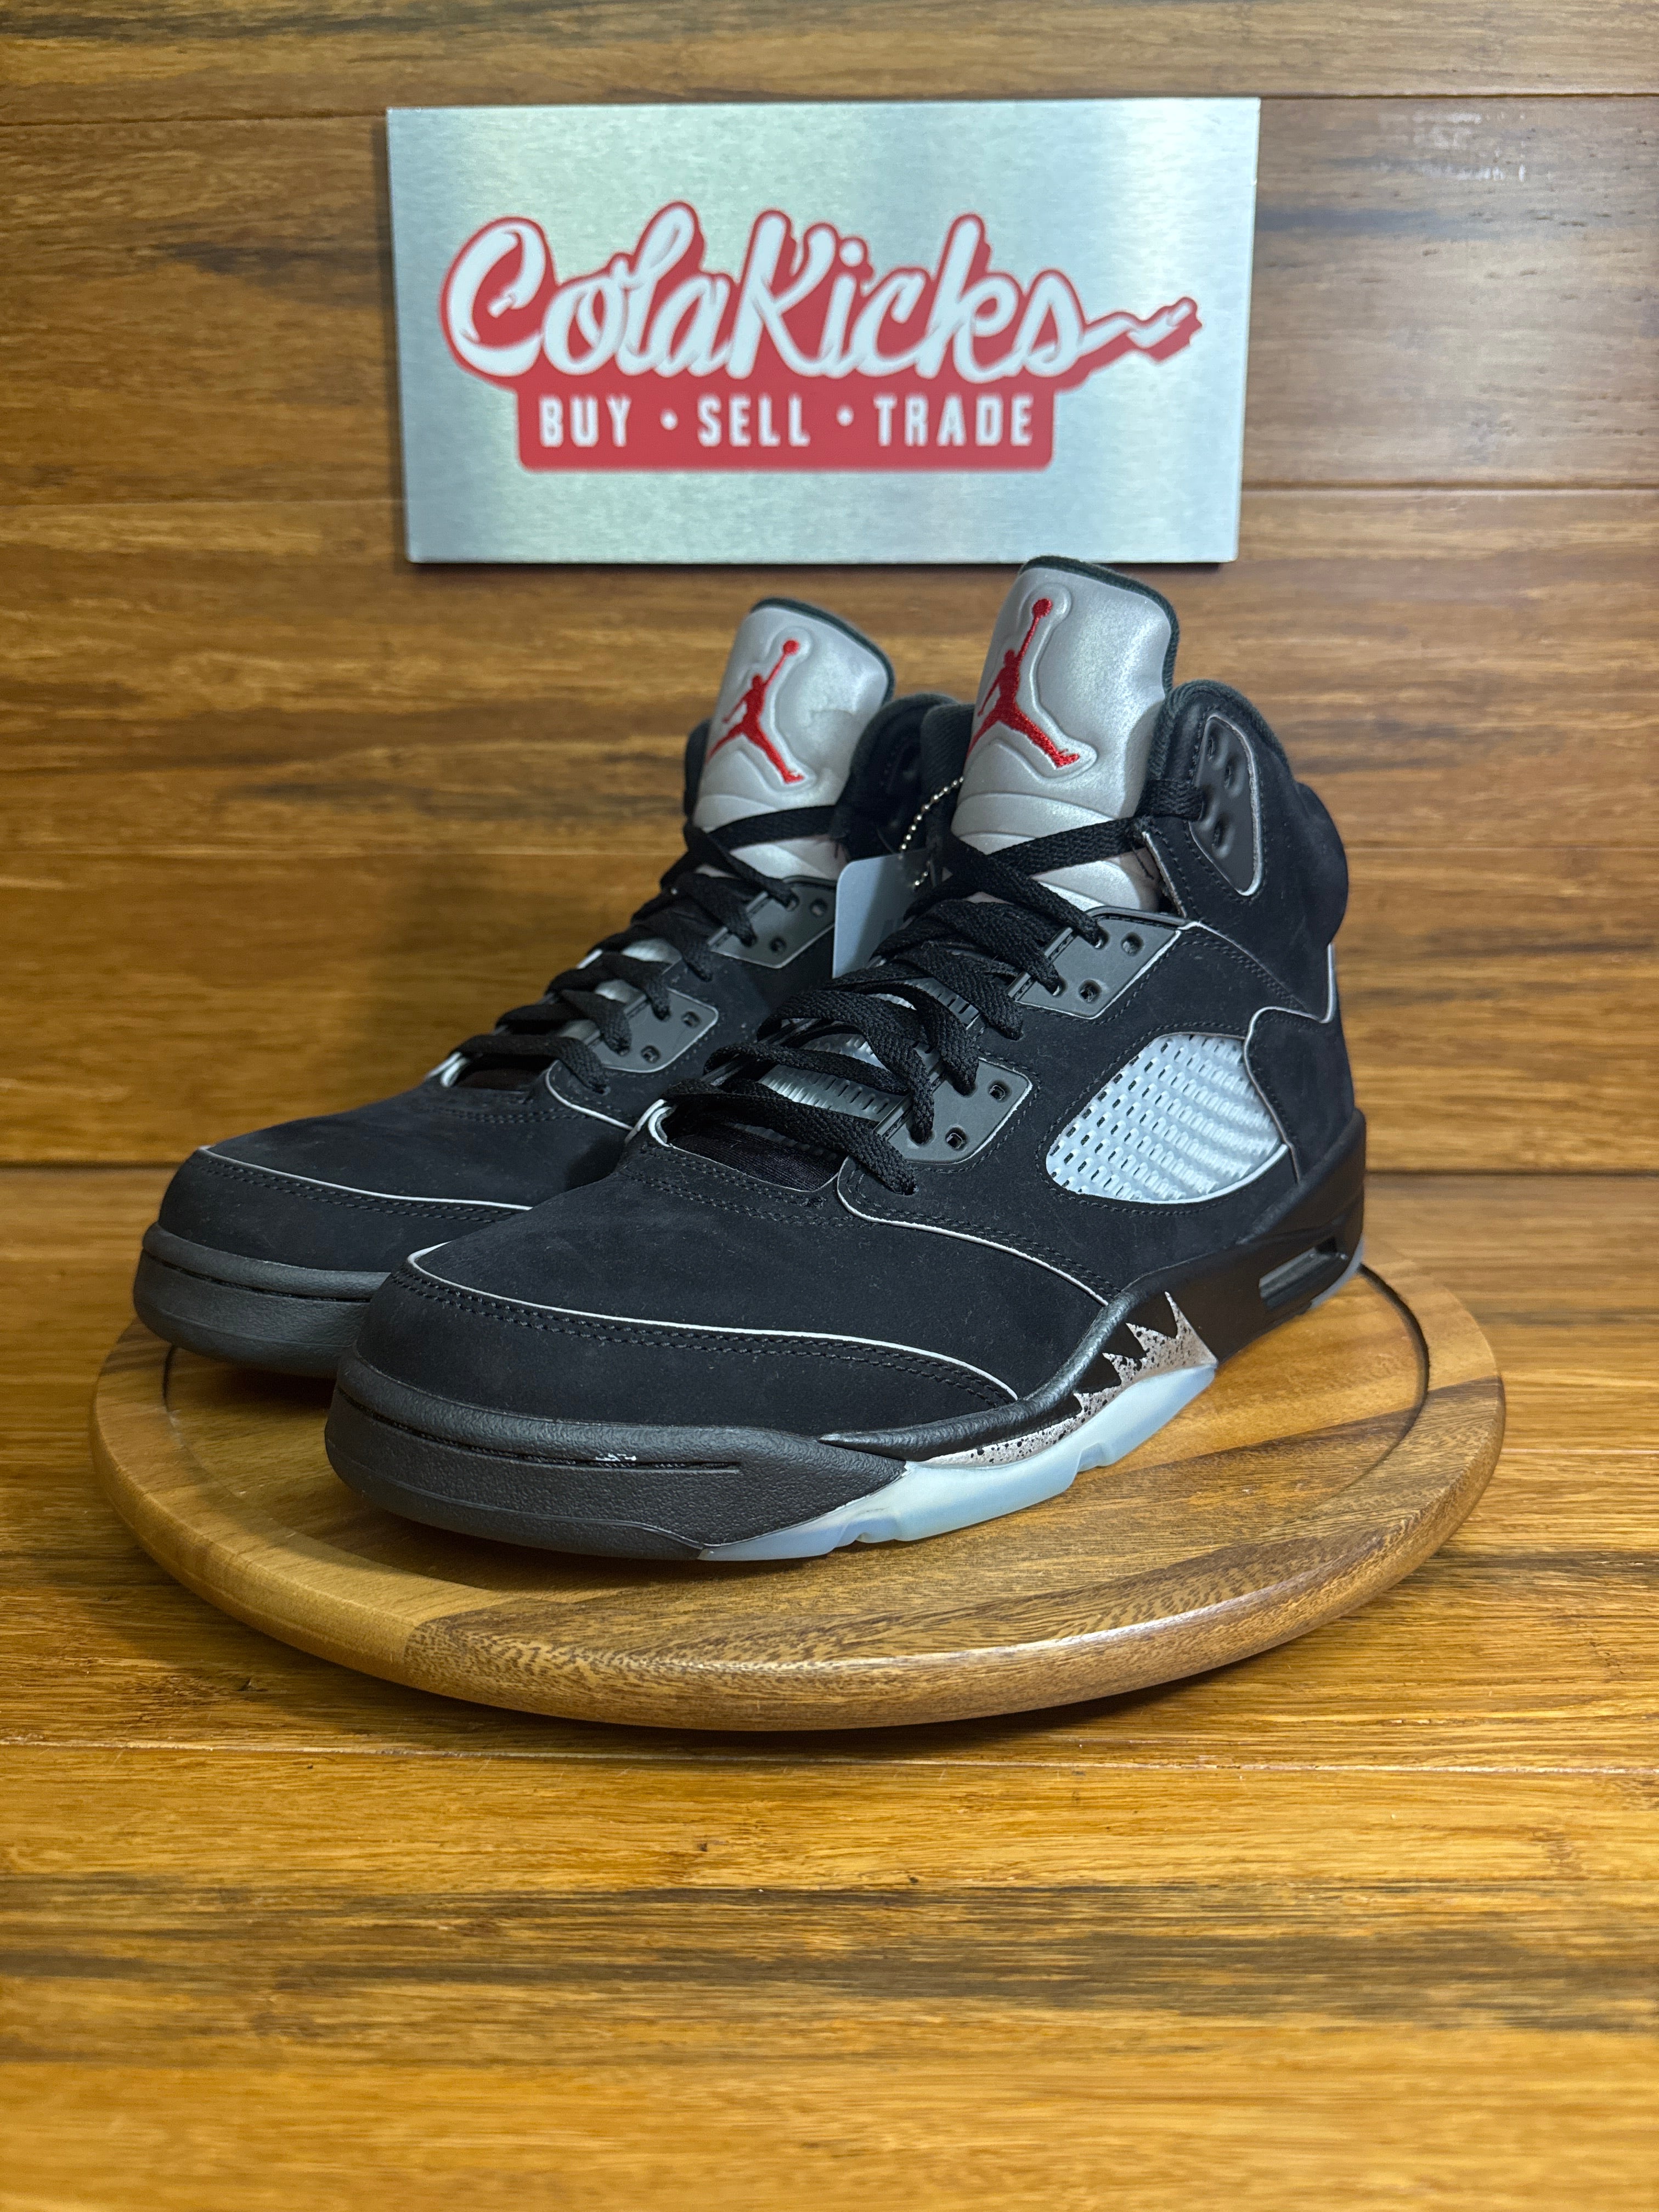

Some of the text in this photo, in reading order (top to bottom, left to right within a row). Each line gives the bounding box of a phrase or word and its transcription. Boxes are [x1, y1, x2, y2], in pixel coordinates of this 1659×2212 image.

[540, 394, 1034, 448] BUY SELL TRADE
